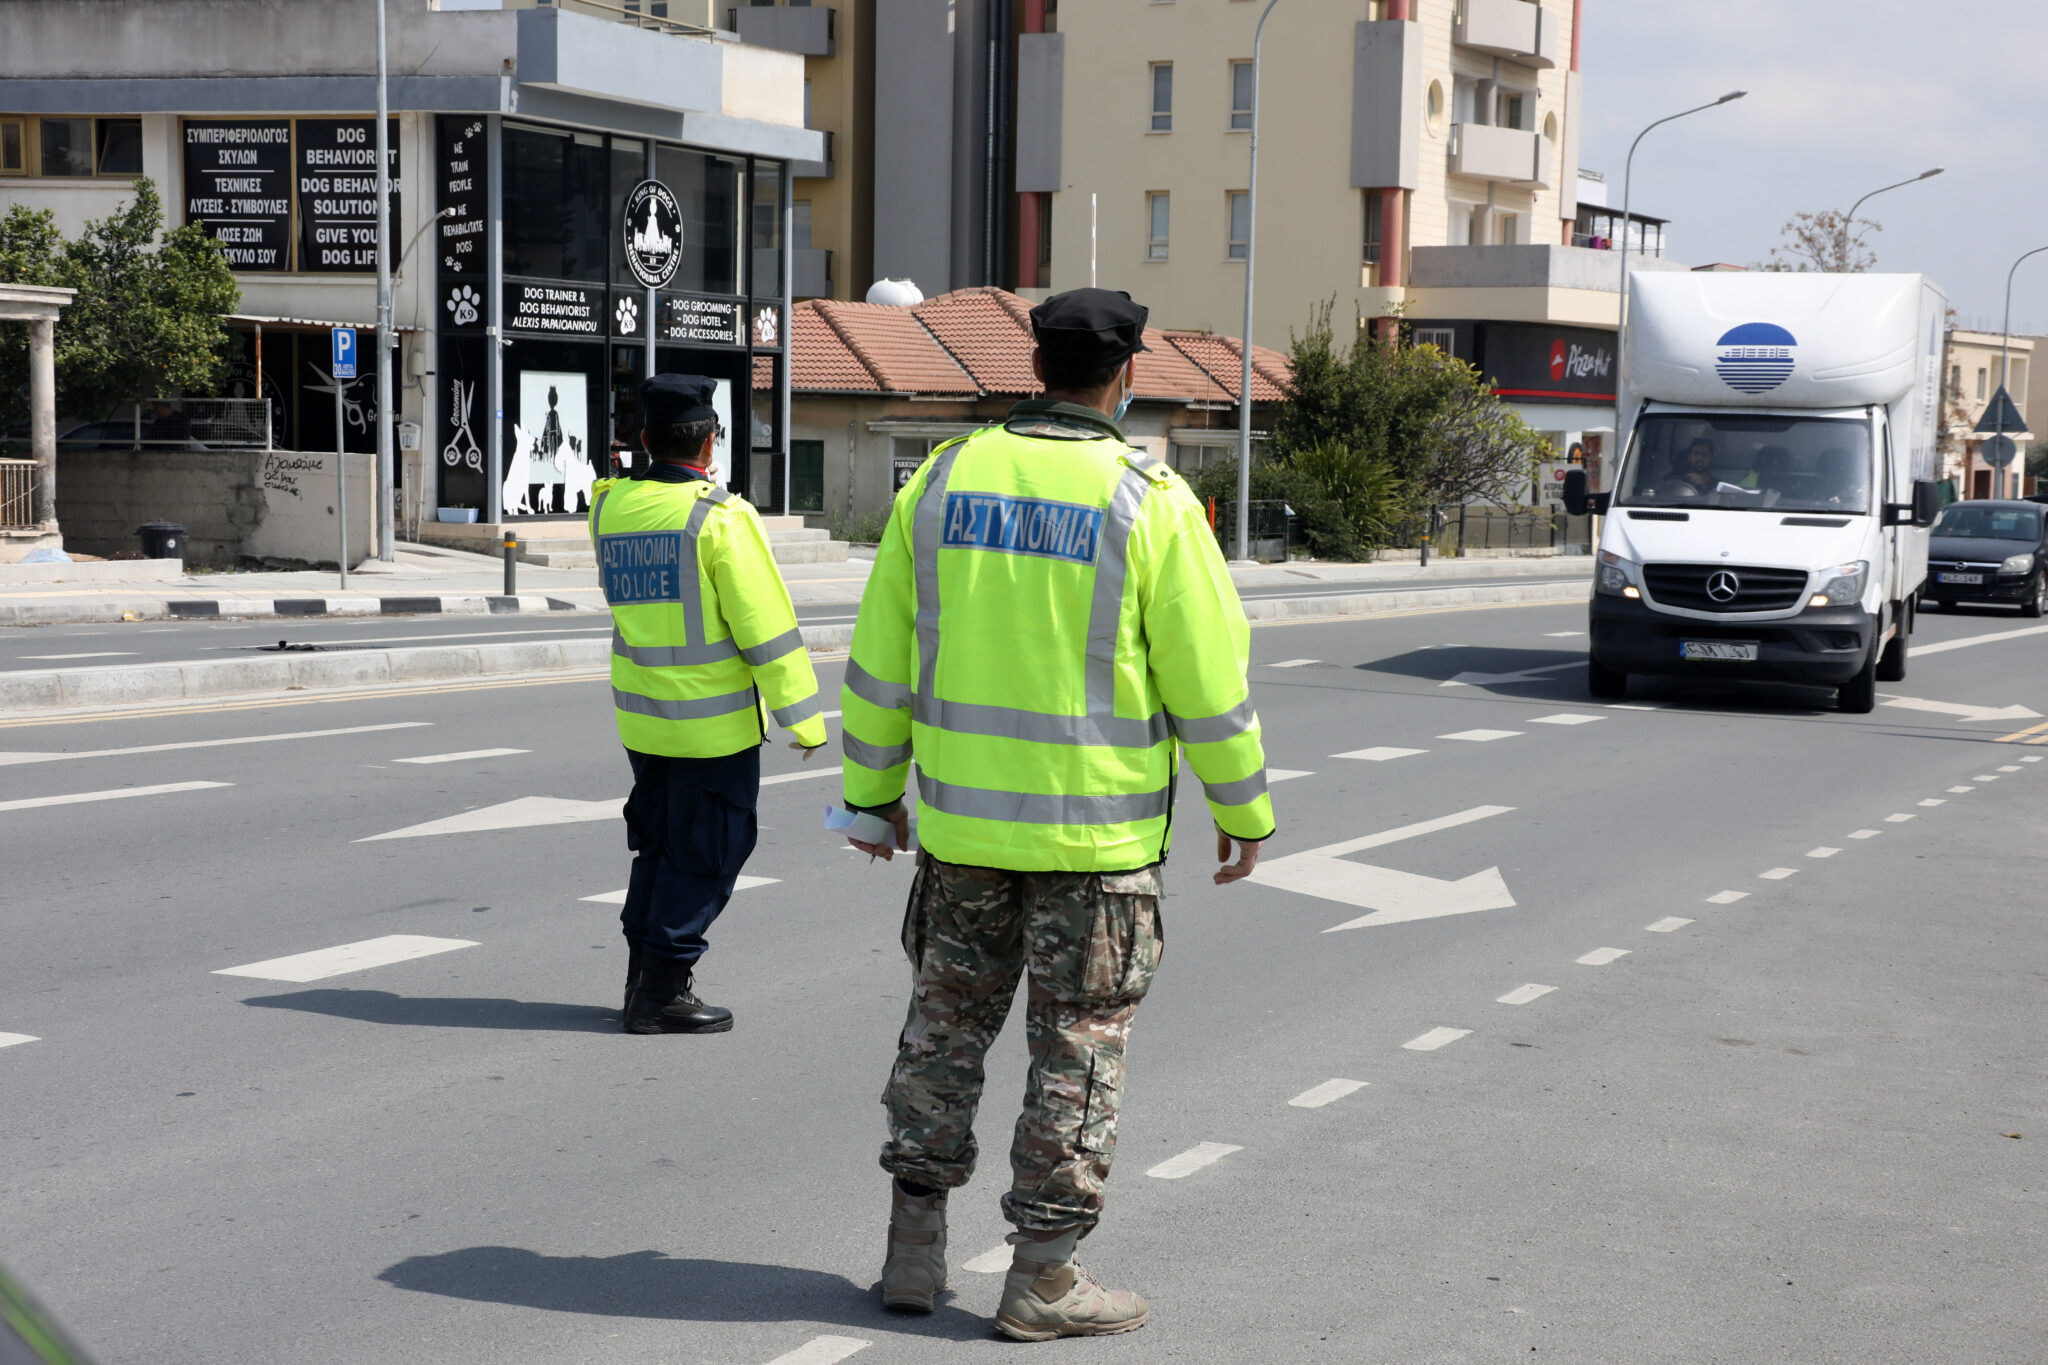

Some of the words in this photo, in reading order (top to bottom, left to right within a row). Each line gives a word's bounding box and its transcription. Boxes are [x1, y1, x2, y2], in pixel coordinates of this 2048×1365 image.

[187, 128, 289, 143] ΣΥΜΠΕΡΙΦΕΡΙΟΛΟΓΟΣ
[336, 128, 366, 143] DOG
[454, 141, 463, 154] WE
[218, 149, 258, 165] ΣΚΥΛΩΝ
[450, 159, 469, 174] TRAIN
[215, 177, 262, 193] ΤΕΧΝΙΚΕΣ
[301, 178, 330, 193] DOG
[333, 178, 401, 193] BEHAVOR
[449, 178, 472, 193] PEOPLE
[634, 186, 649, 204] KING
[648, 185, 658, 194] OF
[657, 187, 674, 209] DOGS
[190, 198, 224, 214] ΛΥΣΕΙΣ
[231, 198, 289, 214] ΣΥΜΒΟΥΛΕΣ
[457, 203, 467, 216] WE
[242, 227, 263, 242] ΖΩΗ
[315, 228, 348, 243] GIVE
[351, 228, 377, 243] YOU
[443, 220, 484, 237] REHABILITATE
[455, 240, 473, 254] DOGS
[257, 249, 277, 264] ΣΟΥ
[322, 249, 351, 264] DOG
[354, 250, 377, 265] LIF
[627, 242, 661, 284] BEHAVIOURAL
[661, 248, 680, 280] CENTRE
[524, 287, 544, 300] DOG
[545, 288, 577, 302] TRAINER
[579, 291, 586, 303] &
[460, 309, 474, 320] K9
[519, 301, 540, 314] DOG
[540, 303, 590, 317] BEHAVIORIST
[672, 299, 690, 311] DOG
[690, 300, 732, 315] GROOMING
[512, 316, 540, 329] ALEXIS
[540, 318, 597, 332] PAPAIOANNOU
[682, 314, 700, 325] DOG
[700, 316, 722, 327] HOTEL
[670, 326, 688, 338] DOG
[688, 328, 734, 341] ACCESSORIES
[337, 331, 351, 361] P
[1565, 343, 1595, 378] Pizza
[1593, 347, 1612, 377] Hut
[450, 378, 461, 427] Grooming
[947, 496, 1094, 559] ΑΣΤΥΝΟΜΙΑ
[603, 536, 678, 569] ΑΣΤΥΝΟΜΙΑ
[612, 570, 670, 600] POLICE
